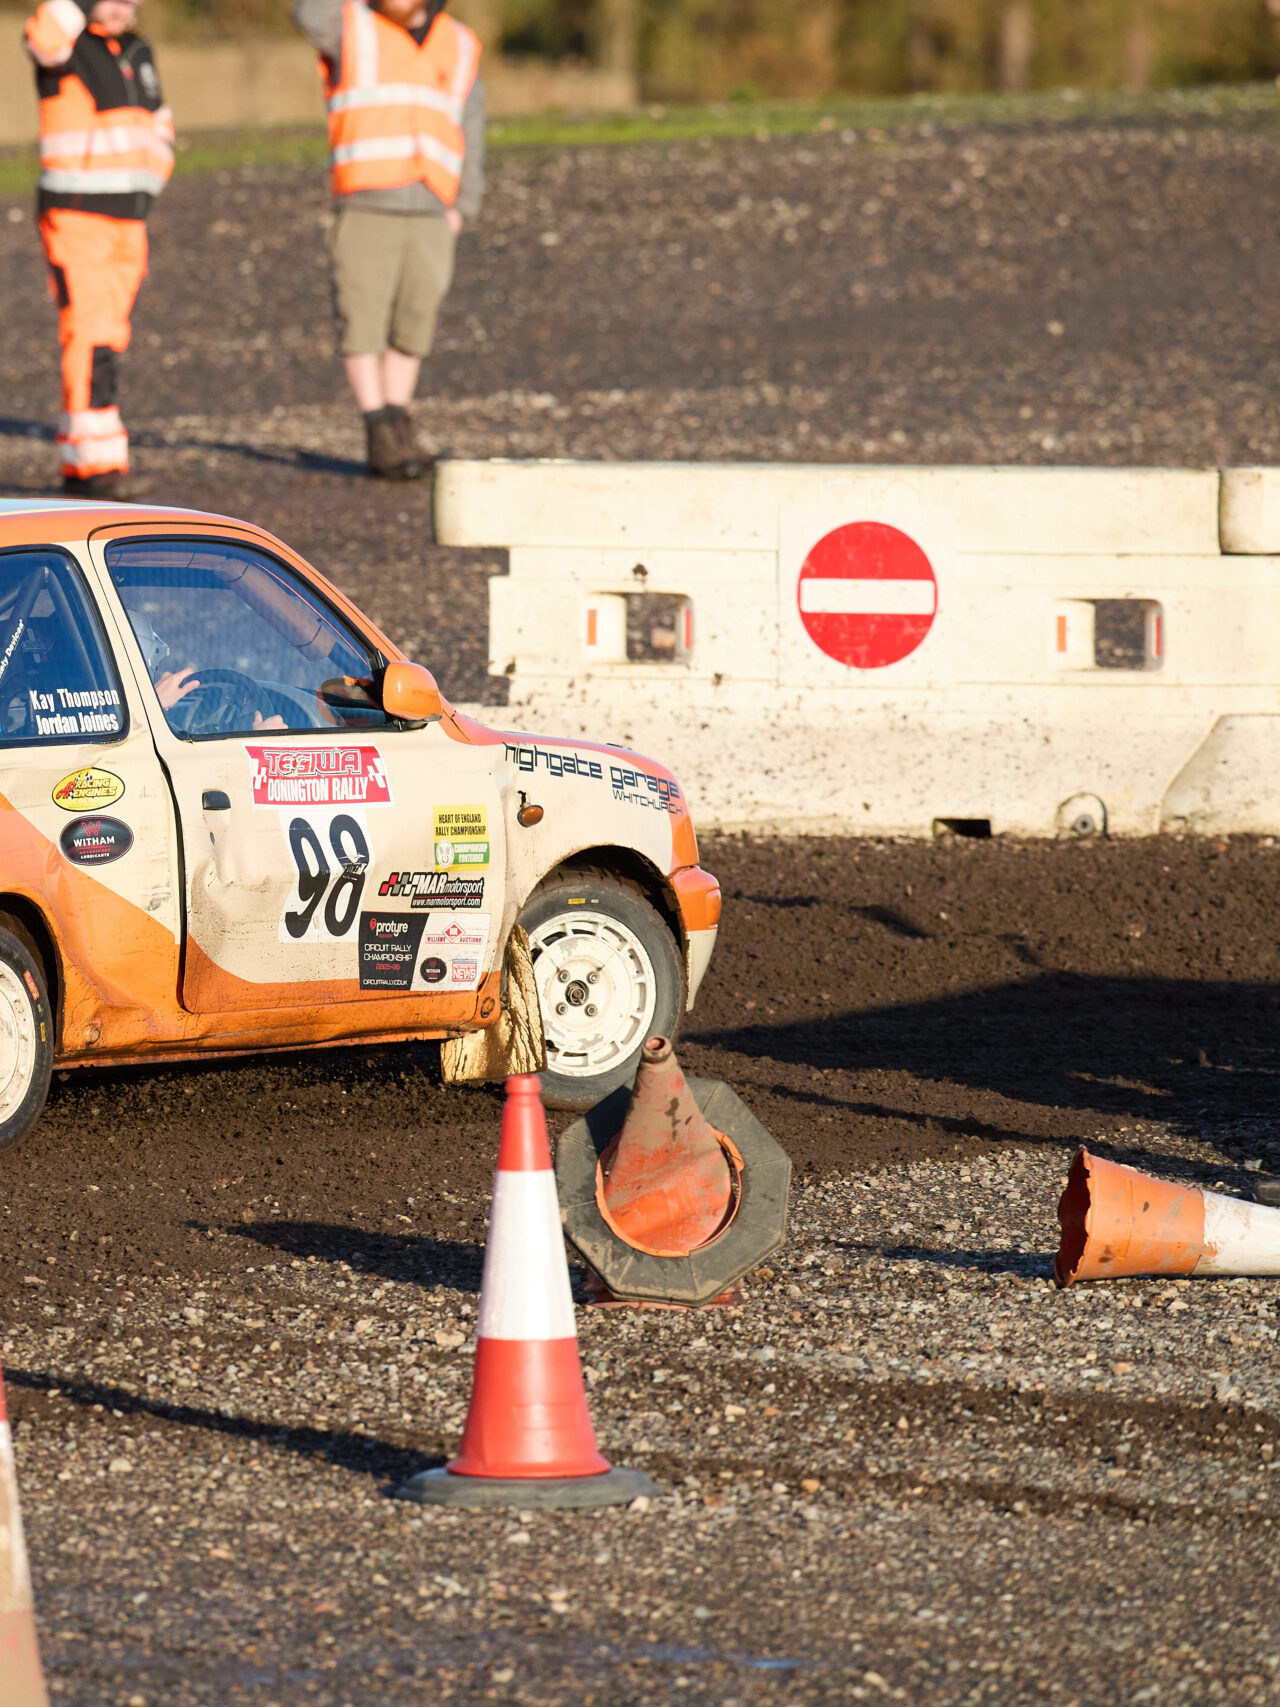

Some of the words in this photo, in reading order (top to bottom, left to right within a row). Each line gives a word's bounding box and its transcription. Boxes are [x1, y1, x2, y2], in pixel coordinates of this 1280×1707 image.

[29, 690, 55, 713] Kay
[56, 688, 120, 710] Thompson
[35, 713, 79, 736] Jordan
[79, 711, 119, 733] Joines
[263, 749, 362, 776] TEGIWA
[502, 741, 603, 780] highgate
[609, 765, 680, 802] garage
[74, 777, 112, 789] RACING
[267, 776, 330, 802] DONINGTON
[331, 776, 369, 801] RALLY
[72, 786, 118, 799] ENGINES
[612, 789, 682, 816] WHITCHURCH
[438, 813, 454, 824] HEART
[455, 813, 461, 823] OF
[461, 813, 482, 823] ENGLAND
[435, 826, 449, 836] RALLY
[450, 825, 486, 836] CHAMPIONSHIP
[73, 835, 115, 847] WITHAM
[285, 813, 370, 939] 98
[411, 896, 481, 908] www.marmotorsport.com
[375, 920, 409, 937] protyre
[364, 943, 390, 952] CIRCUIT
[390, 944, 412, 952] RALLY
[363, 953, 413, 962] CHAMPIONSHIP
[452, 967, 476, 980] NEWS
